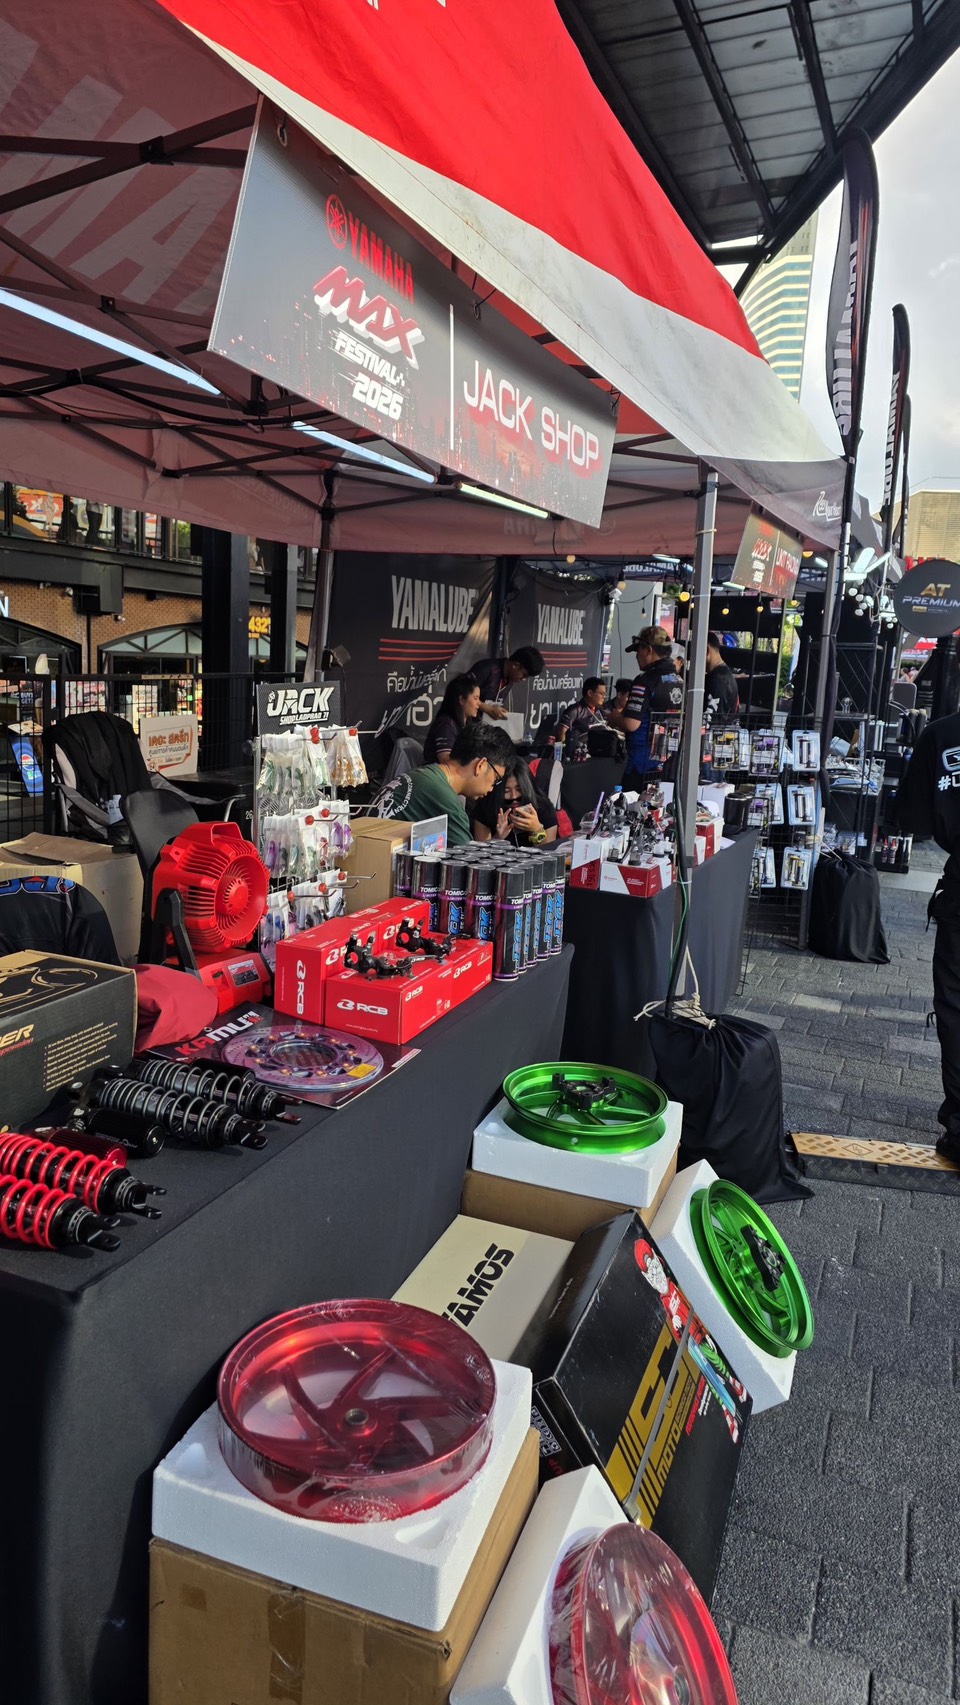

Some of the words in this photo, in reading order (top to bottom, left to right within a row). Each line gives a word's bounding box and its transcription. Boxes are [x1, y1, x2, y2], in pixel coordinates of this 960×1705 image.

[348, 211, 415, 304] YAMAHA
[313, 266, 422, 368] MAX
[334, 330, 402, 386] FESTIVAL
[351, 371, 404, 421] 2026
[463, 360, 533, 440] JACK
[541, 406, 599, 469] SHOP
[391, 575, 476, 633] YAMALUBE
[902, 595, 960, 607] PREMIUM
[920, 583, 951, 597] AT
[537, 603, 585, 645] YAMALUBE
[266, 687, 335, 717] JACK
[460, 961, 472, 973] RCB
[297, 981, 305, 1015] RCB
[356, 1003, 388, 1016] RCB
[411, 985, 423, 996] RCB
[657, 1426, 682, 1488] MOTO
